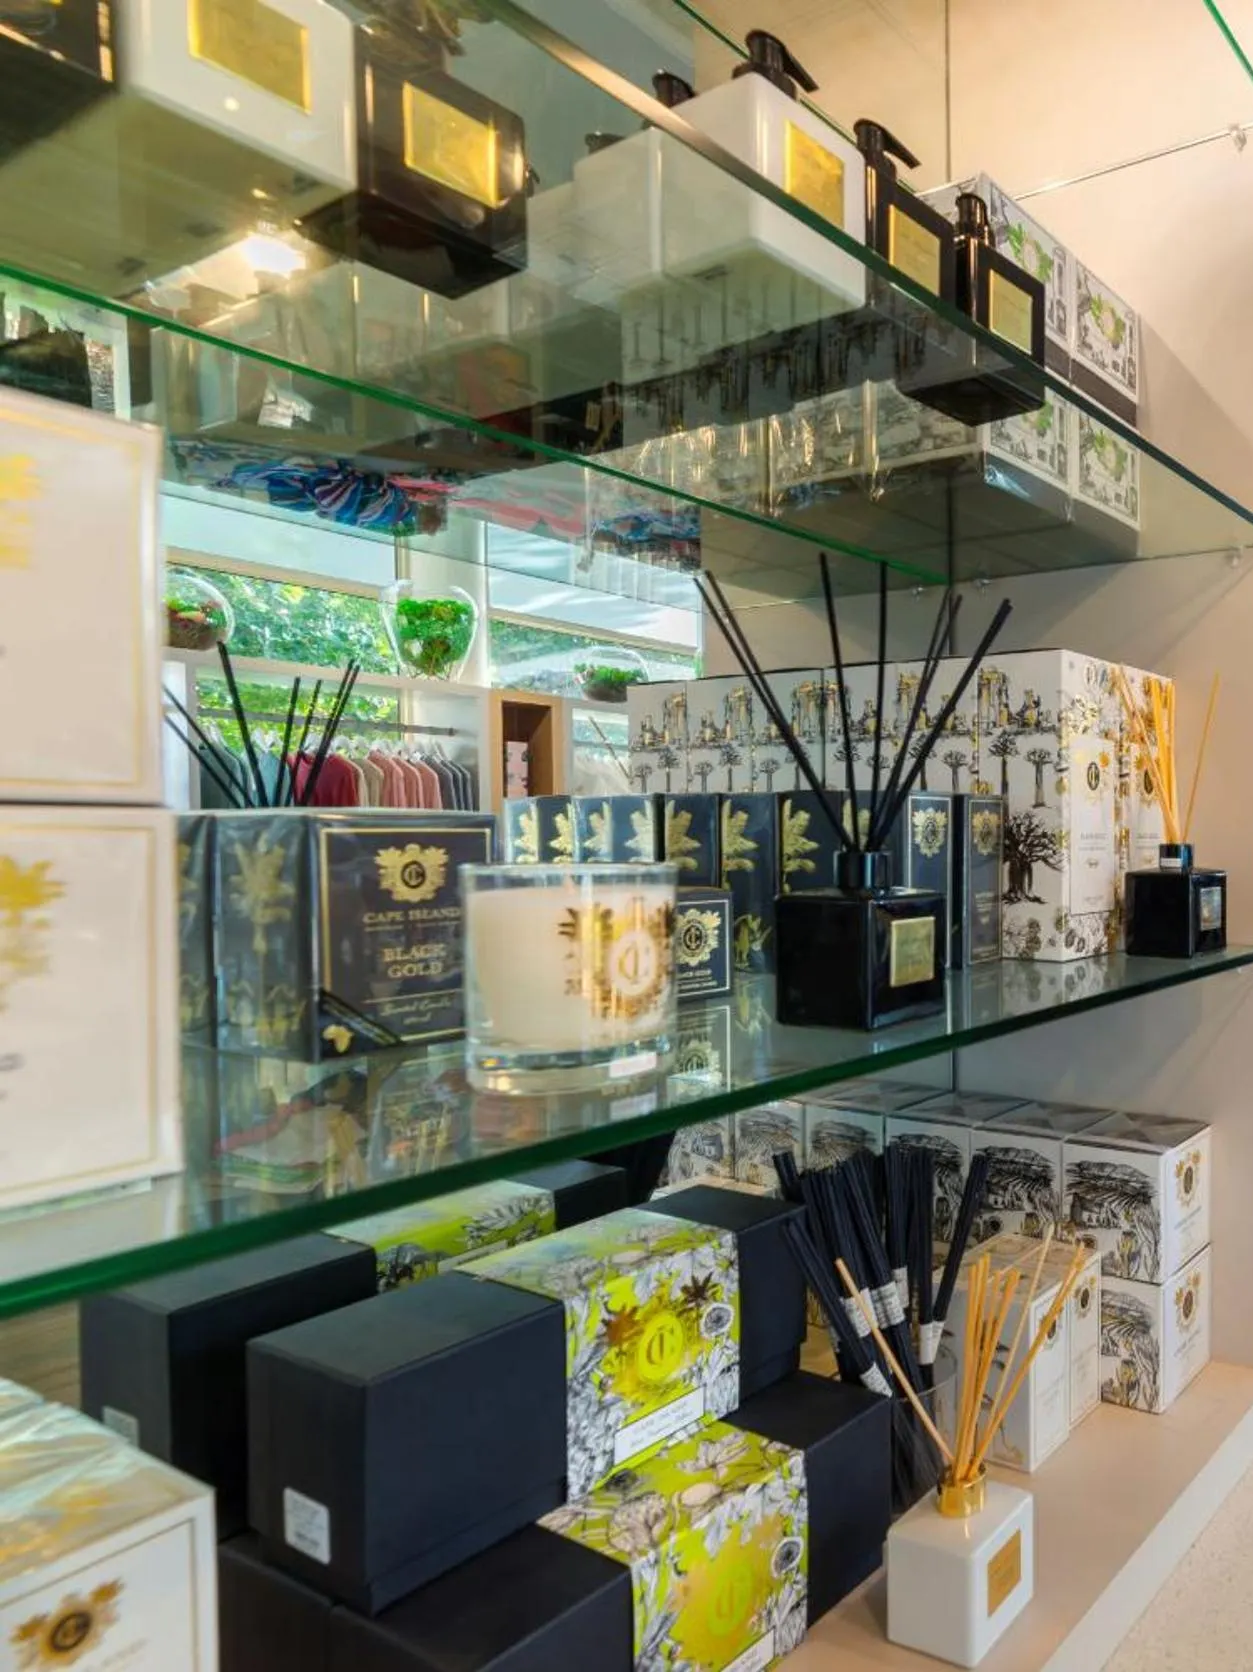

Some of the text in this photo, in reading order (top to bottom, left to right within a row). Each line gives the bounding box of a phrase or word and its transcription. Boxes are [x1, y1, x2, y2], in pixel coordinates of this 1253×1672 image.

[363, 911, 404, 924] CAPE
[383, 943, 447, 962] BLACK
[387, 961, 444, 978] GOLD
